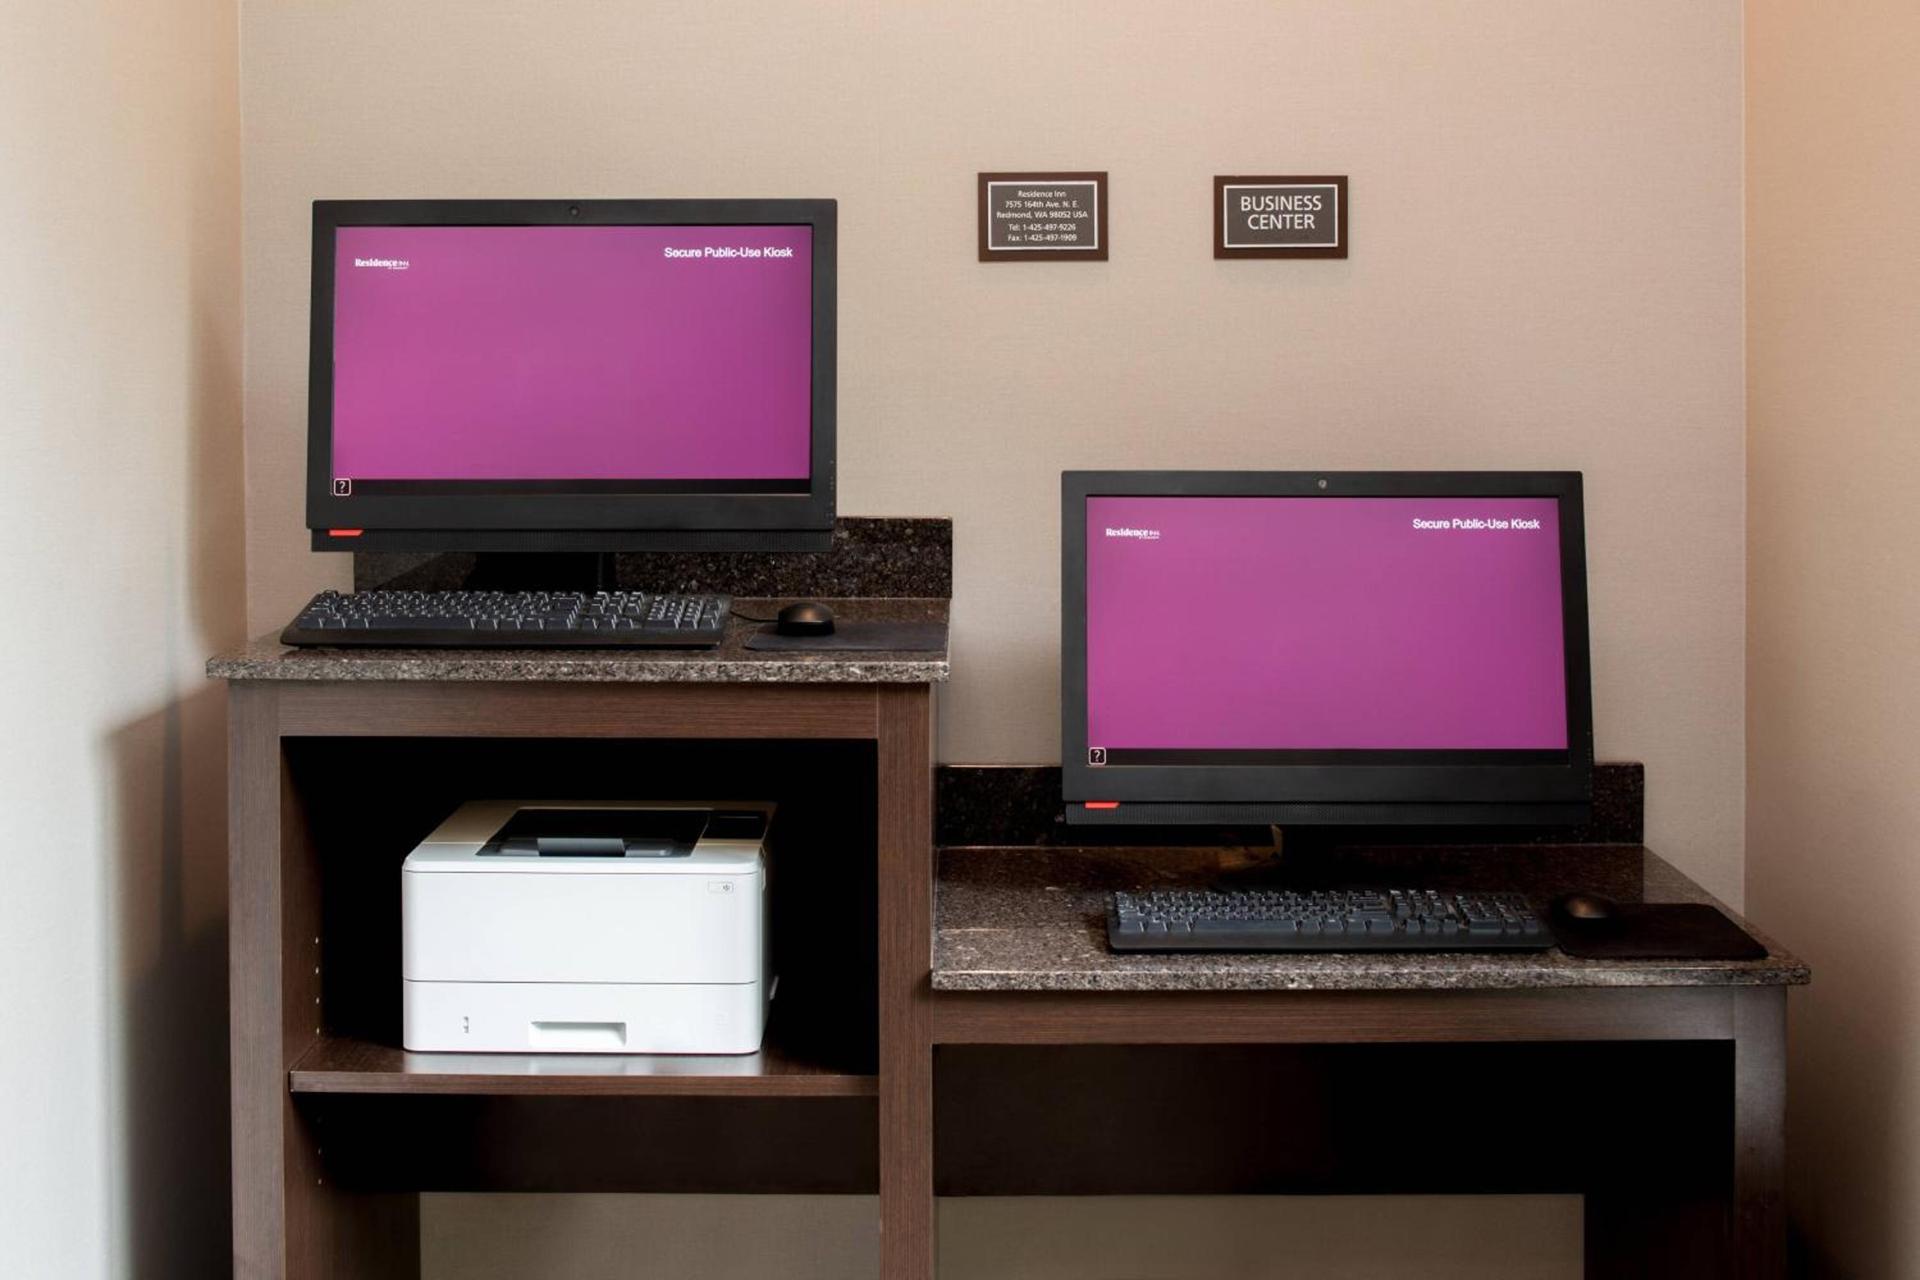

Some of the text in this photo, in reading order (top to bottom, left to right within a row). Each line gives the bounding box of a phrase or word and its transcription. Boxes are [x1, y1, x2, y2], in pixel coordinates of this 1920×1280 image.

[1018, 190, 1067, 198] Residence Inn
[1005, 200, 1022, 208] 7575
[1024, 200, 1044, 208] 164th
[1240, 195, 1322, 211] BUSINESS
[996, 210, 1088, 219] Redmond, WA 98052 USA
[1247, 213, 1316, 230] CENTER
[664, 247, 793, 258] Secure Public-Use Kiosk
[355, 258, 398, 267] Residence
[1412, 518, 1540, 529] Secure Public-Use Kiosk
[1106, 528, 1148, 537] Residence
